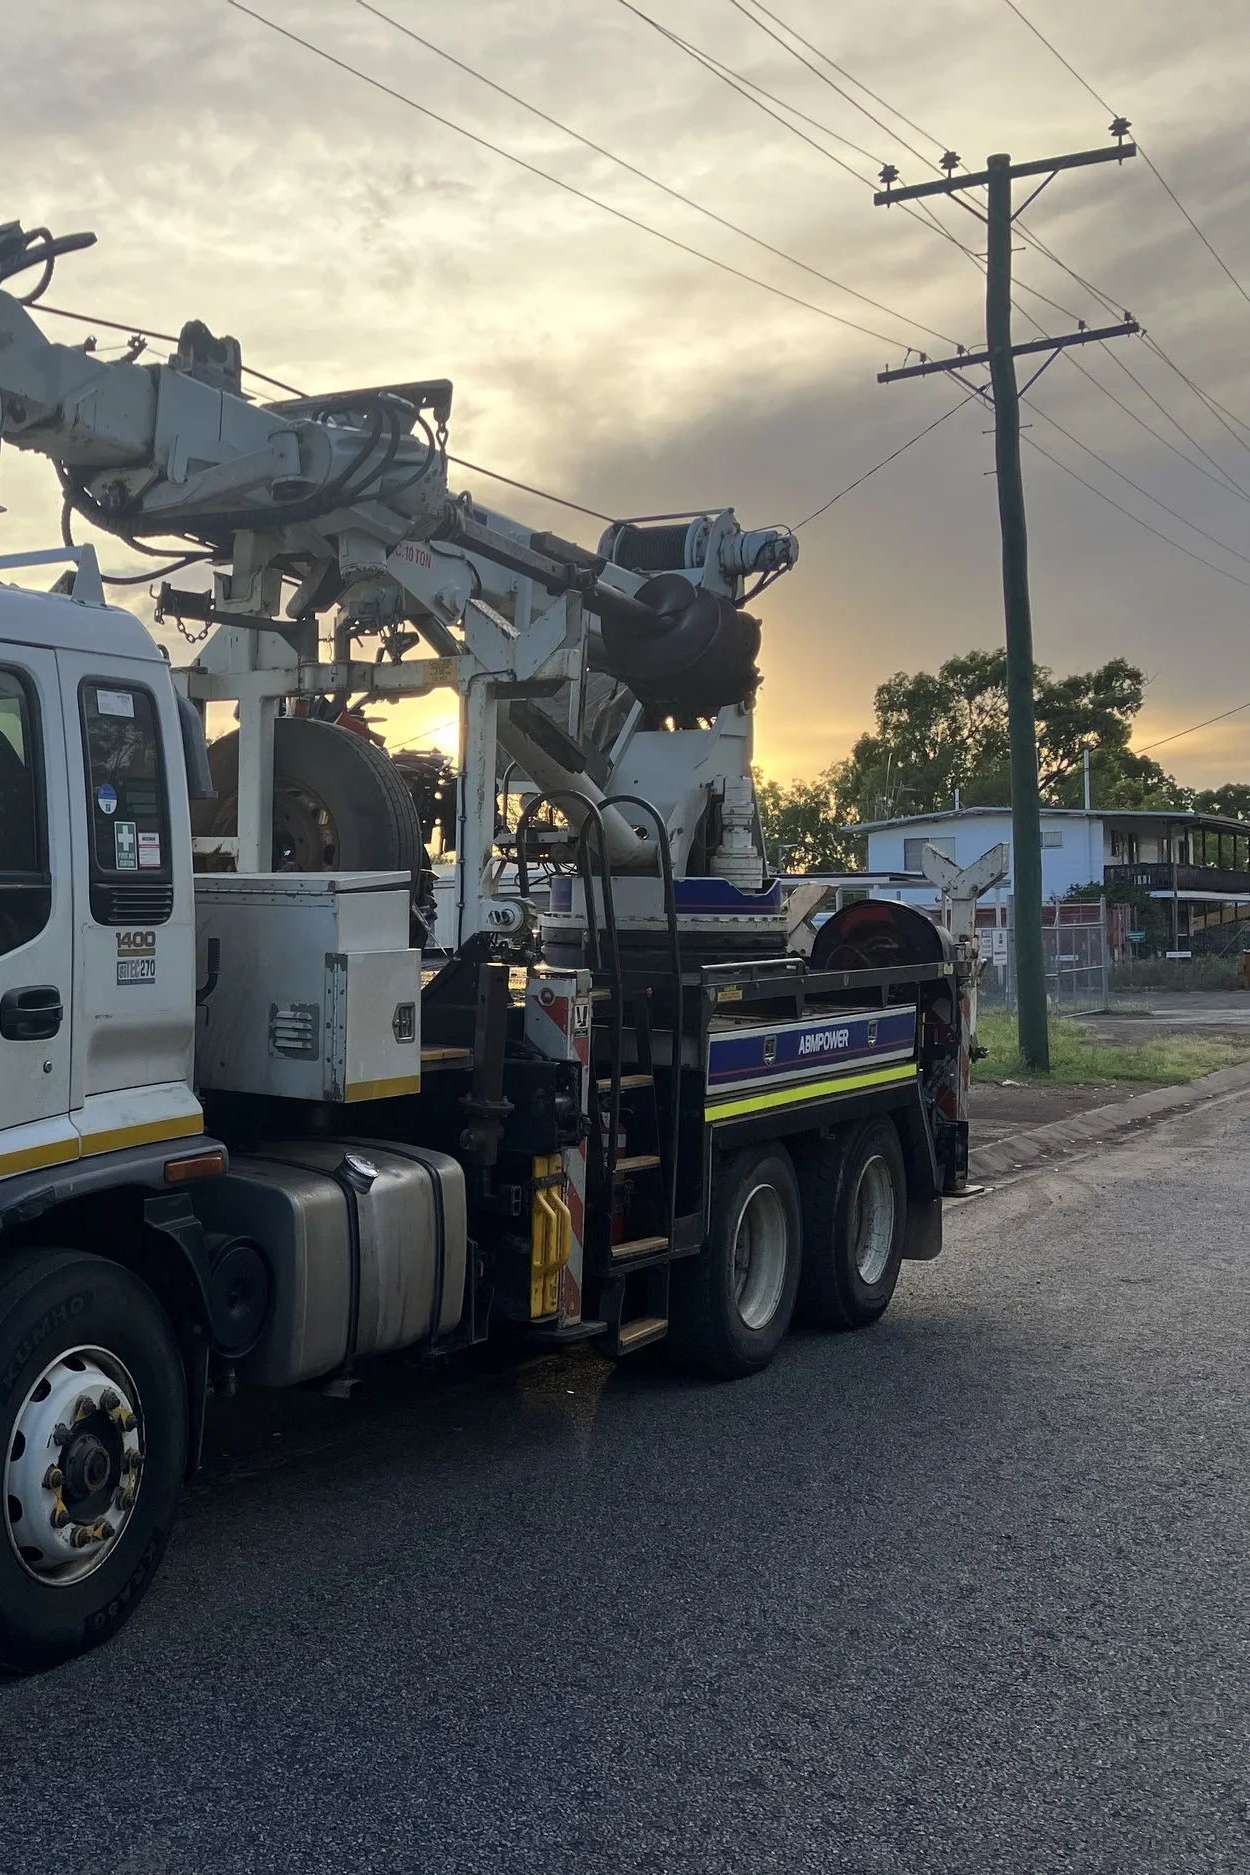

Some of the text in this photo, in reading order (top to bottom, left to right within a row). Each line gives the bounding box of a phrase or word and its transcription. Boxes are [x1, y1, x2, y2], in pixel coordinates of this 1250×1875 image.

[405, 545, 414, 562] 10
[415, 548, 432, 569] TON
[116, 931, 156, 948] 1400
[2, 1296, 85, 1389] KUMHO
